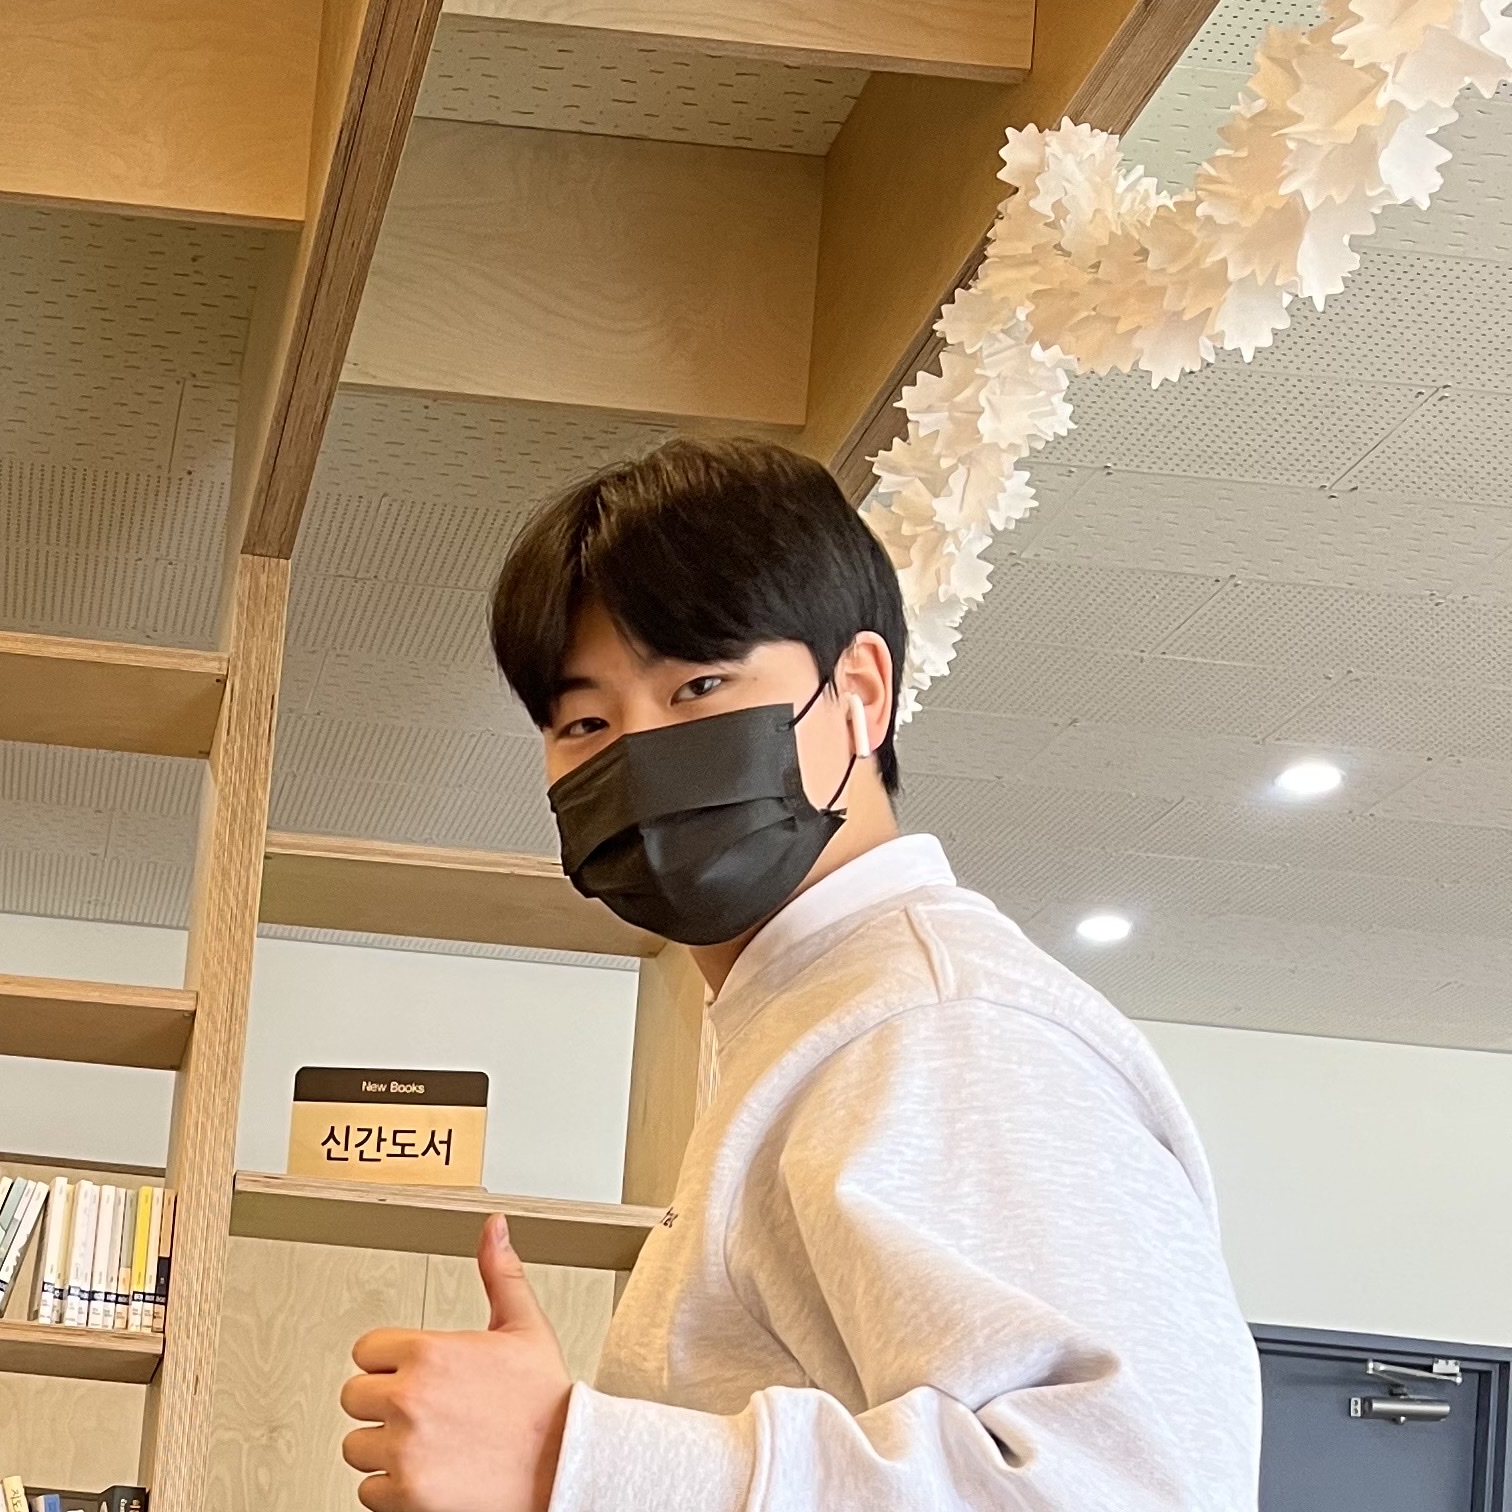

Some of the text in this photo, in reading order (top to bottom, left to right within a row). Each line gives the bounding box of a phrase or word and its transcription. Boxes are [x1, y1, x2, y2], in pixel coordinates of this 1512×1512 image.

[361, 1080, 425, 1094] New Books
[320, 1125, 453, 1166] 신간도서
